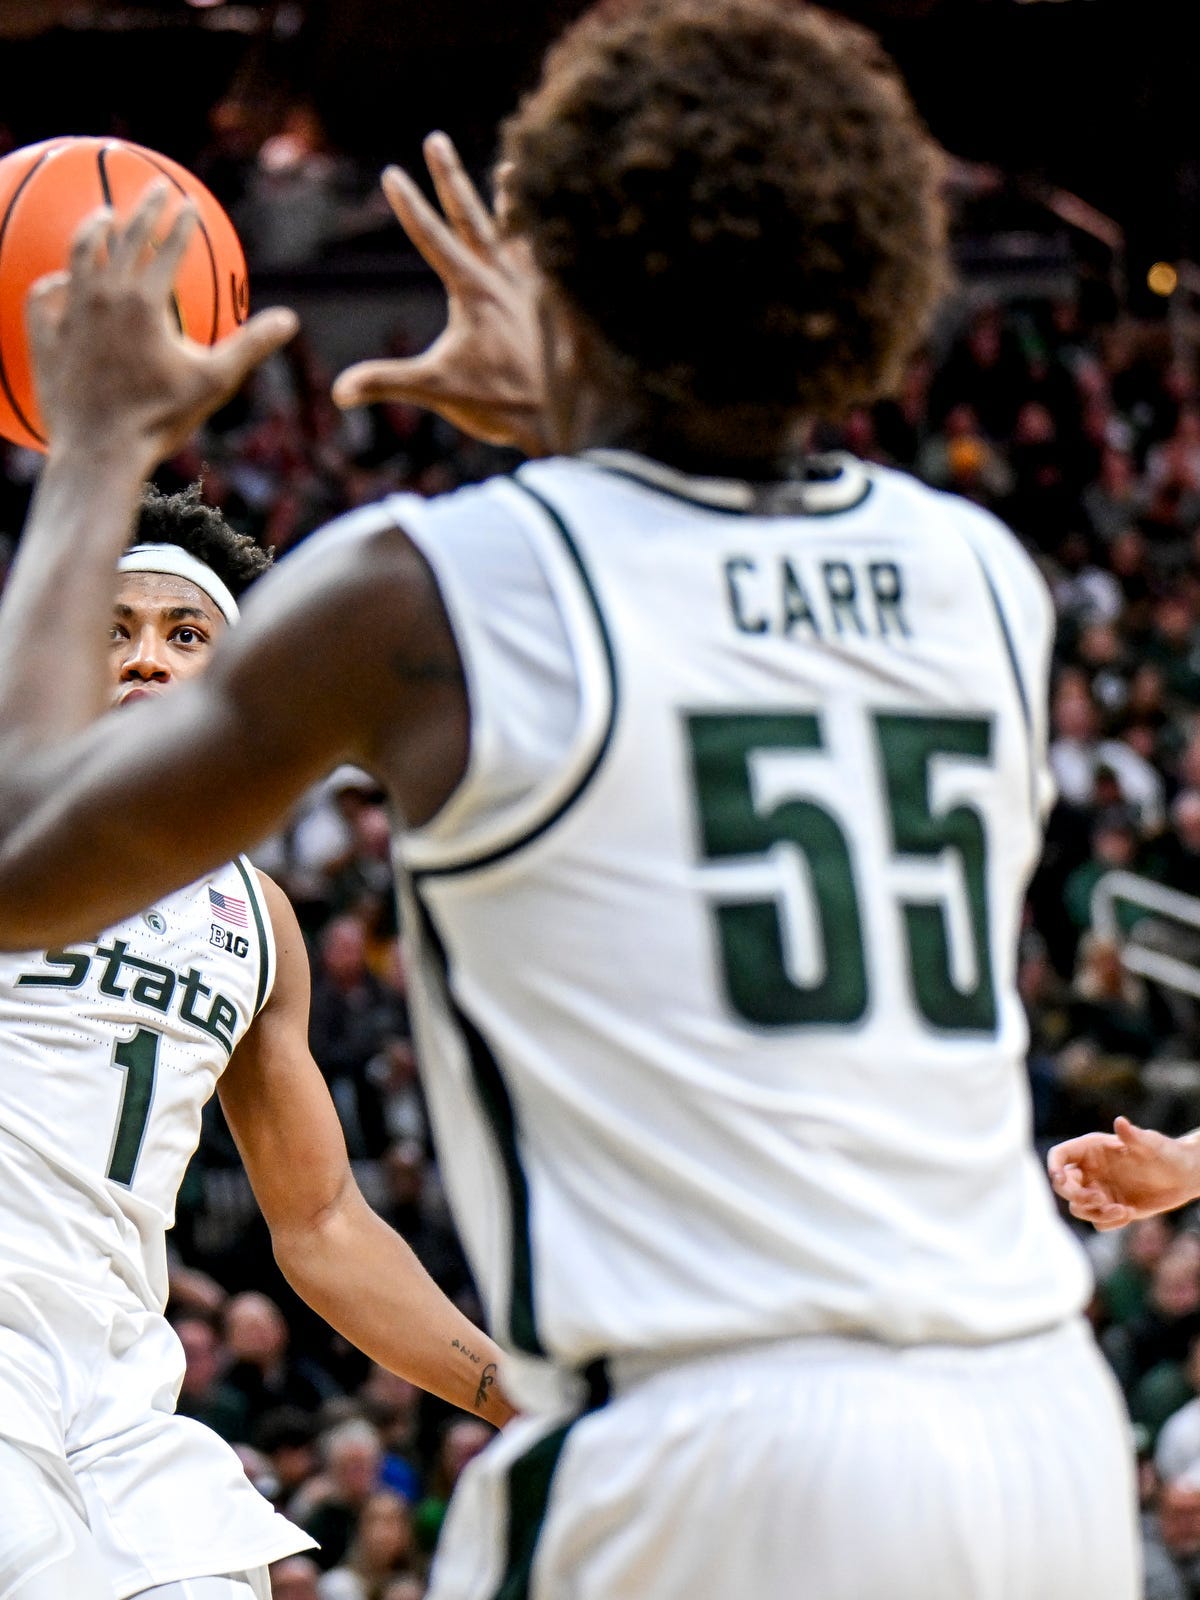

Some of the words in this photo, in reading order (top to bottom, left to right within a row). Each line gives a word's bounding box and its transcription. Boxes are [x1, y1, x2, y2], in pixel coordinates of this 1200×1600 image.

[722, 554, 914, 640] CARR
[679, 706, 1001, 1039] 55
[13, 935, 239, 1059] State
[104, 1022, 163, 1192] 1
